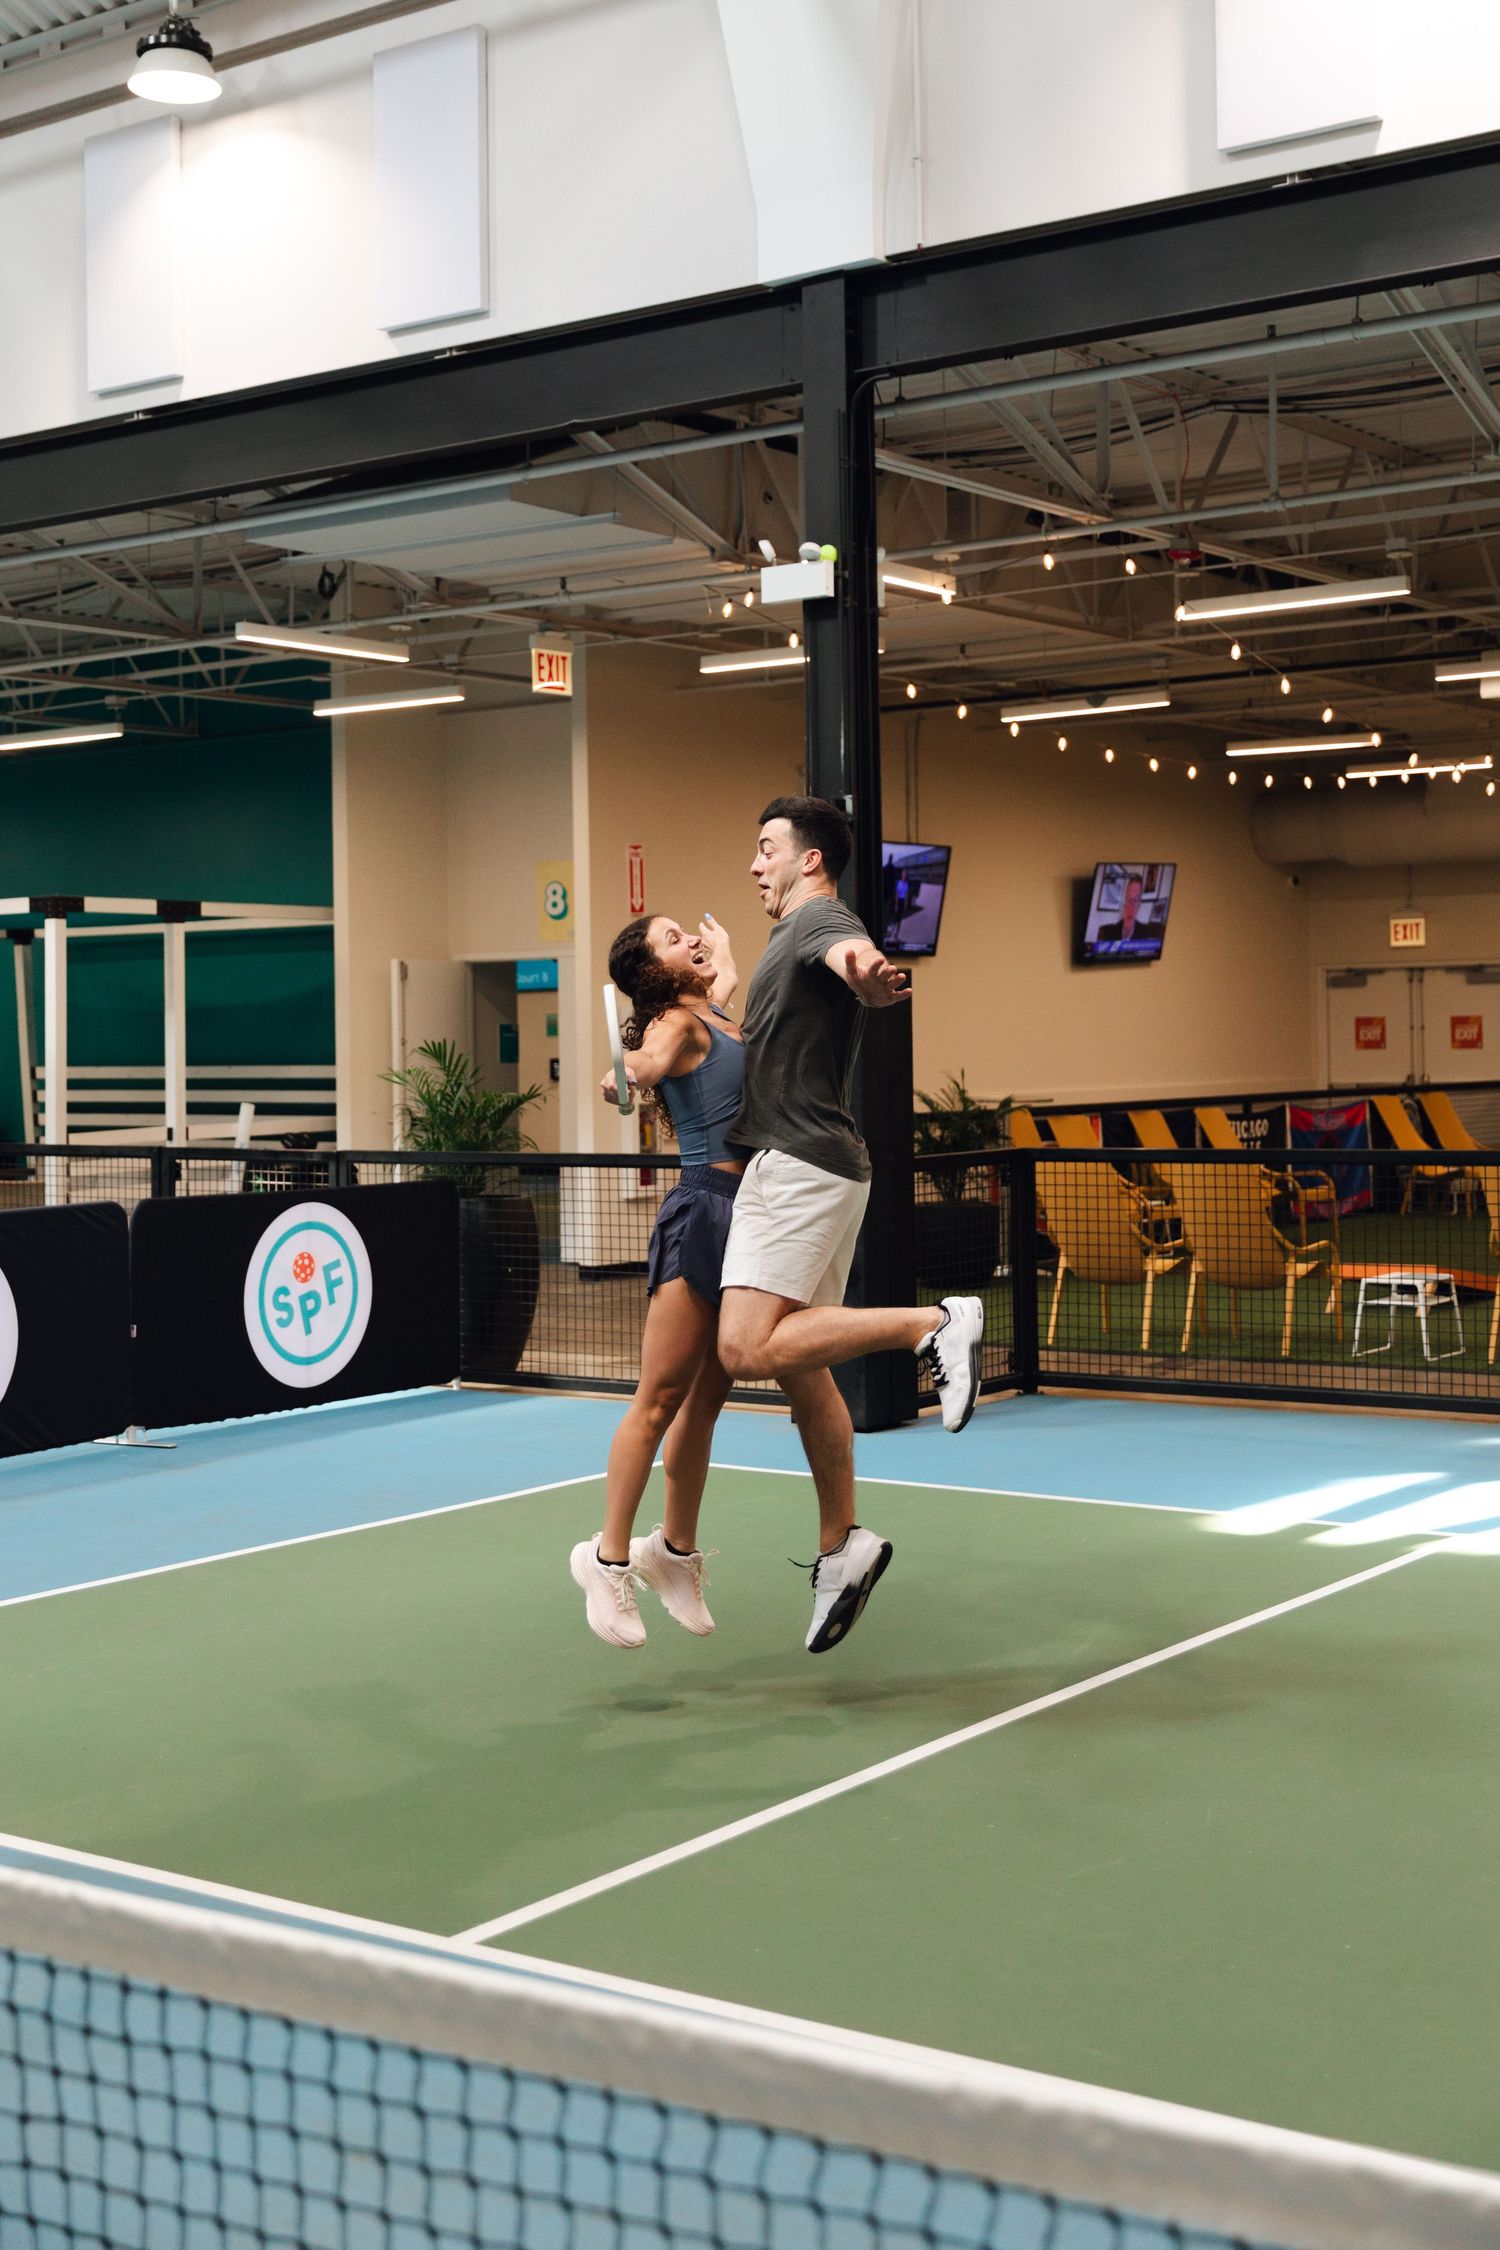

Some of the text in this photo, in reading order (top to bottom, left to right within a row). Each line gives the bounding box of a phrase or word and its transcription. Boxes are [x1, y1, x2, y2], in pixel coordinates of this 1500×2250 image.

[537, 652, 568, 684] EXIT
[544, 880, 569, 921] 8
[1393, 922, 1421, 942] EXIT
[1359, 1029, 1382, 1041] EXIT
[1455, 1028, 1479, 1041] EXIT
[272, 1258, 344, 1336] SPF
